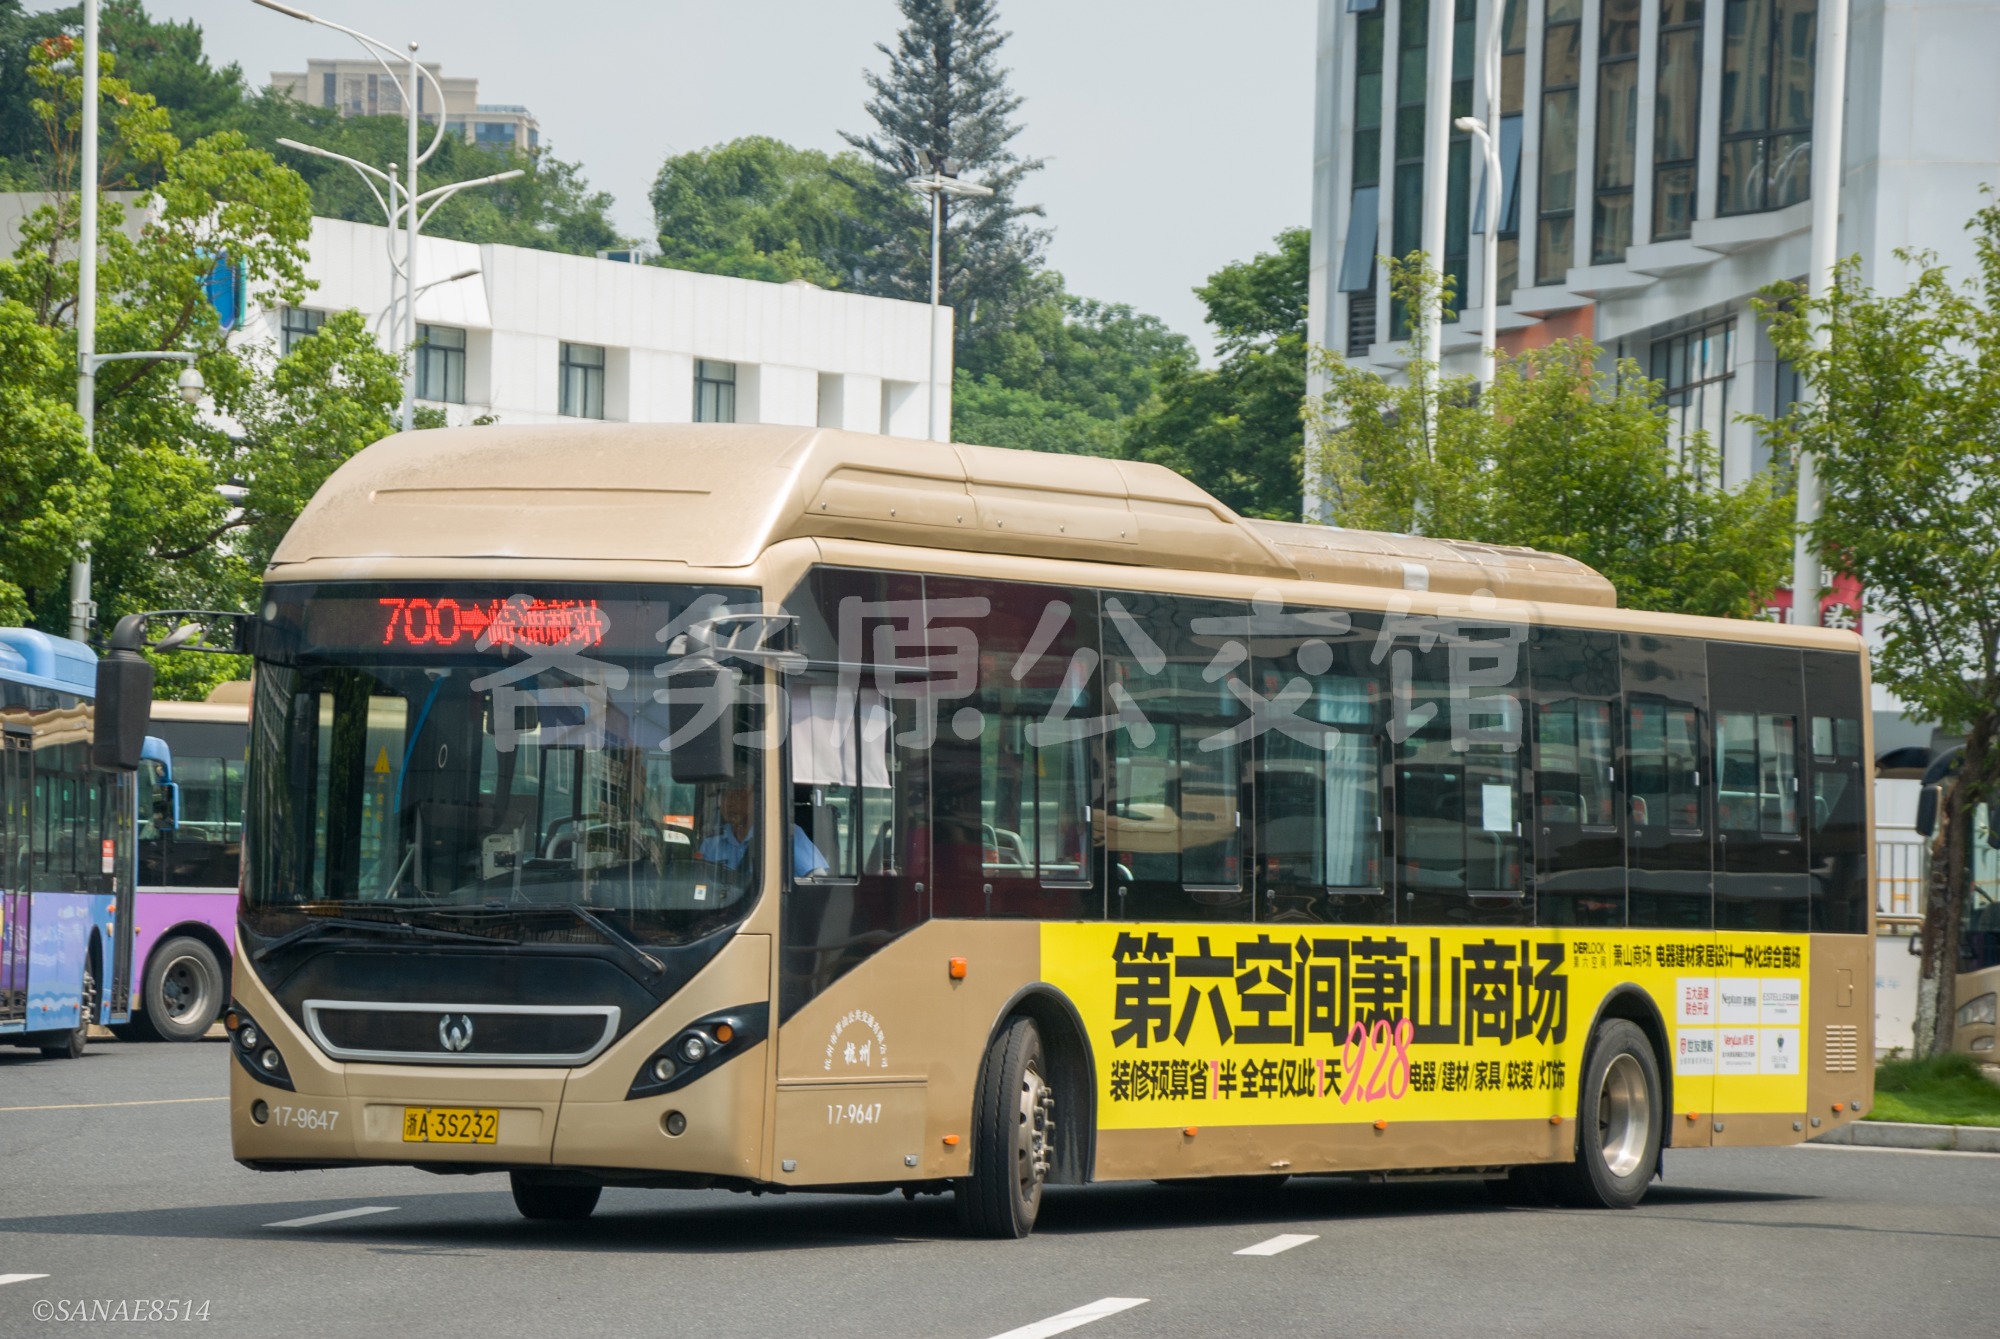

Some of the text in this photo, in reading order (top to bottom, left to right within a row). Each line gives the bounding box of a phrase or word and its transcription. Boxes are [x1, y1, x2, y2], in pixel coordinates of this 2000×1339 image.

[379, 598, 459, 644] 700
[1573, 942, 1606, 954] DERLOOK
[1613, 944, 1801, 969] 萧山商场 电器建材家居设计一体化综合商场
[1111, 932, 1569, 1048] 第六空间萧山商场
[844, 1039, 872, 1068] 杭州
[1339, 1017, 1415, 1105] 9.28
[1110, 1058, 1343, 1101] 装修预算省1半 全年仅此1天
[273, 1106, 339, 1131] 17-9647
[827, 1103, 882, 1125] 17-9647
